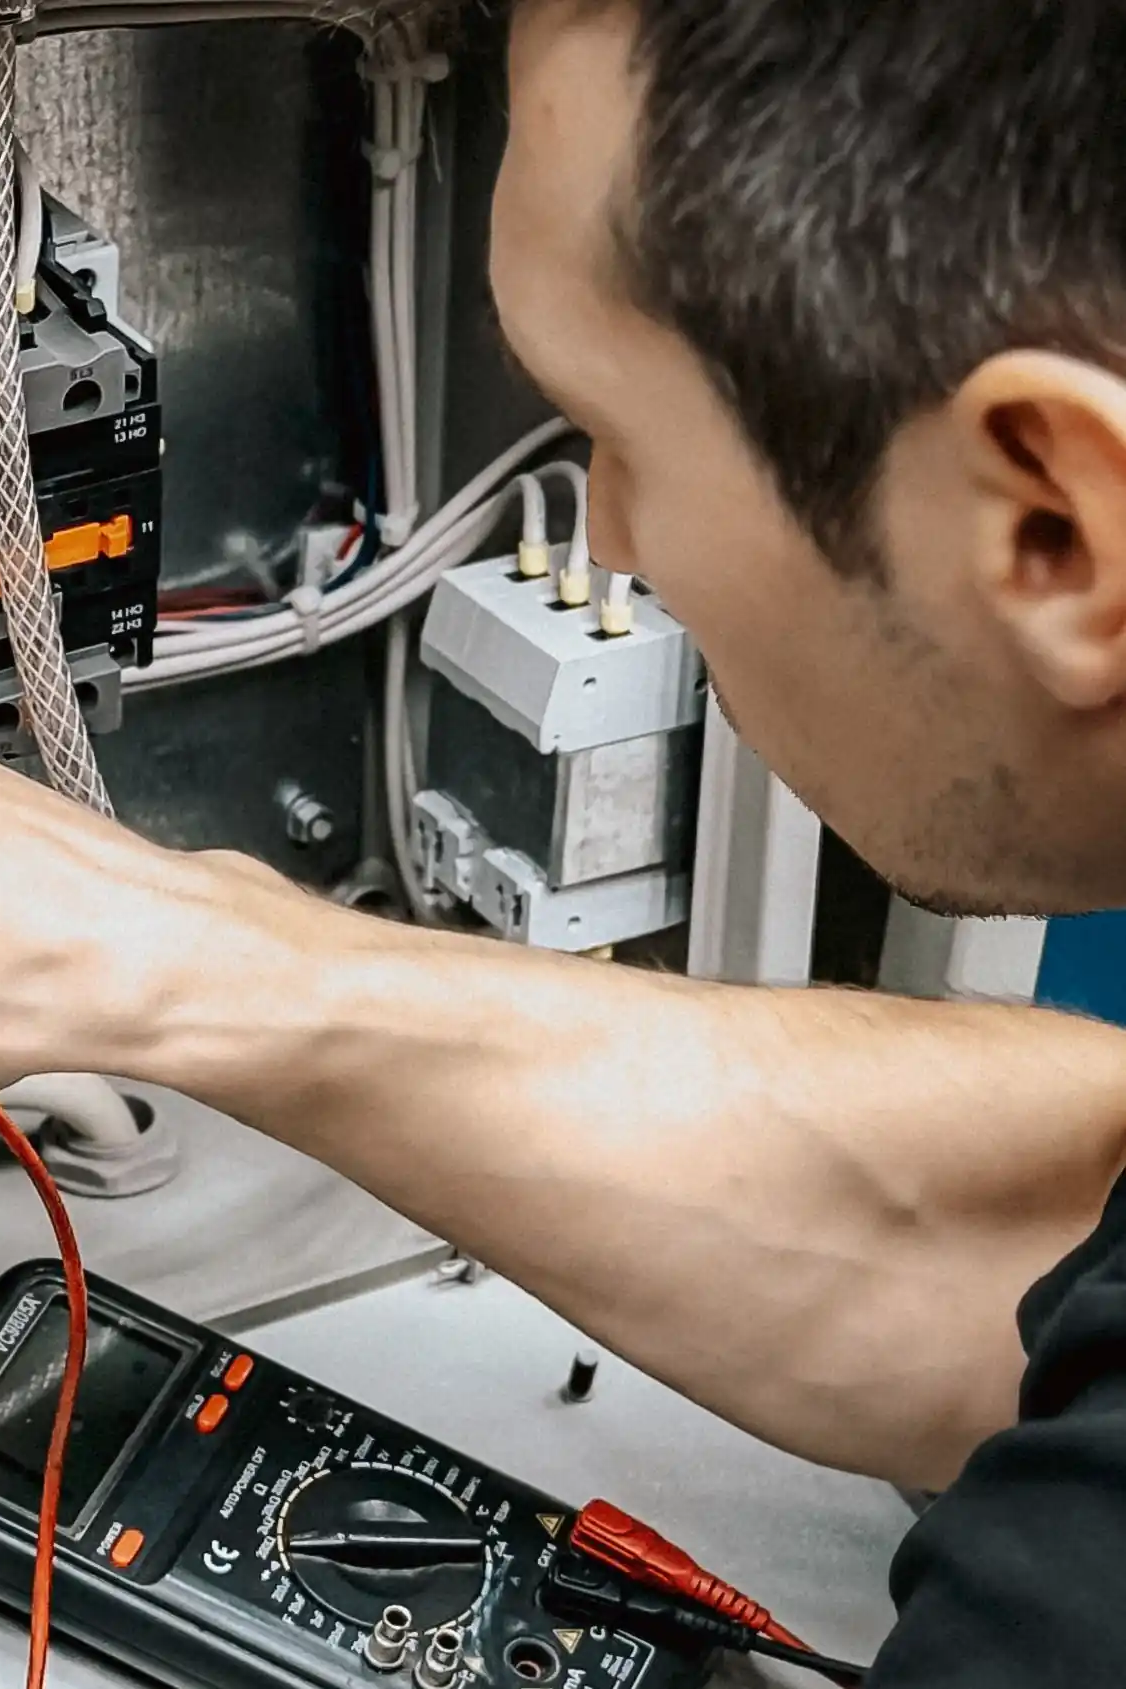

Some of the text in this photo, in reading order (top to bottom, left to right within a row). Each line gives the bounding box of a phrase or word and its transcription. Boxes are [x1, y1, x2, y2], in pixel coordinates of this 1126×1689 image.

[114, 418, 127, 430] 21
[114, 431, 126, 443] 13
[219, 1492, 240, 1519] AUTO
[232, 1462, 259, 1495] POWER
[96, 1521, 123, 1556] POWER
[203, 1539, 241, 1575] CE
